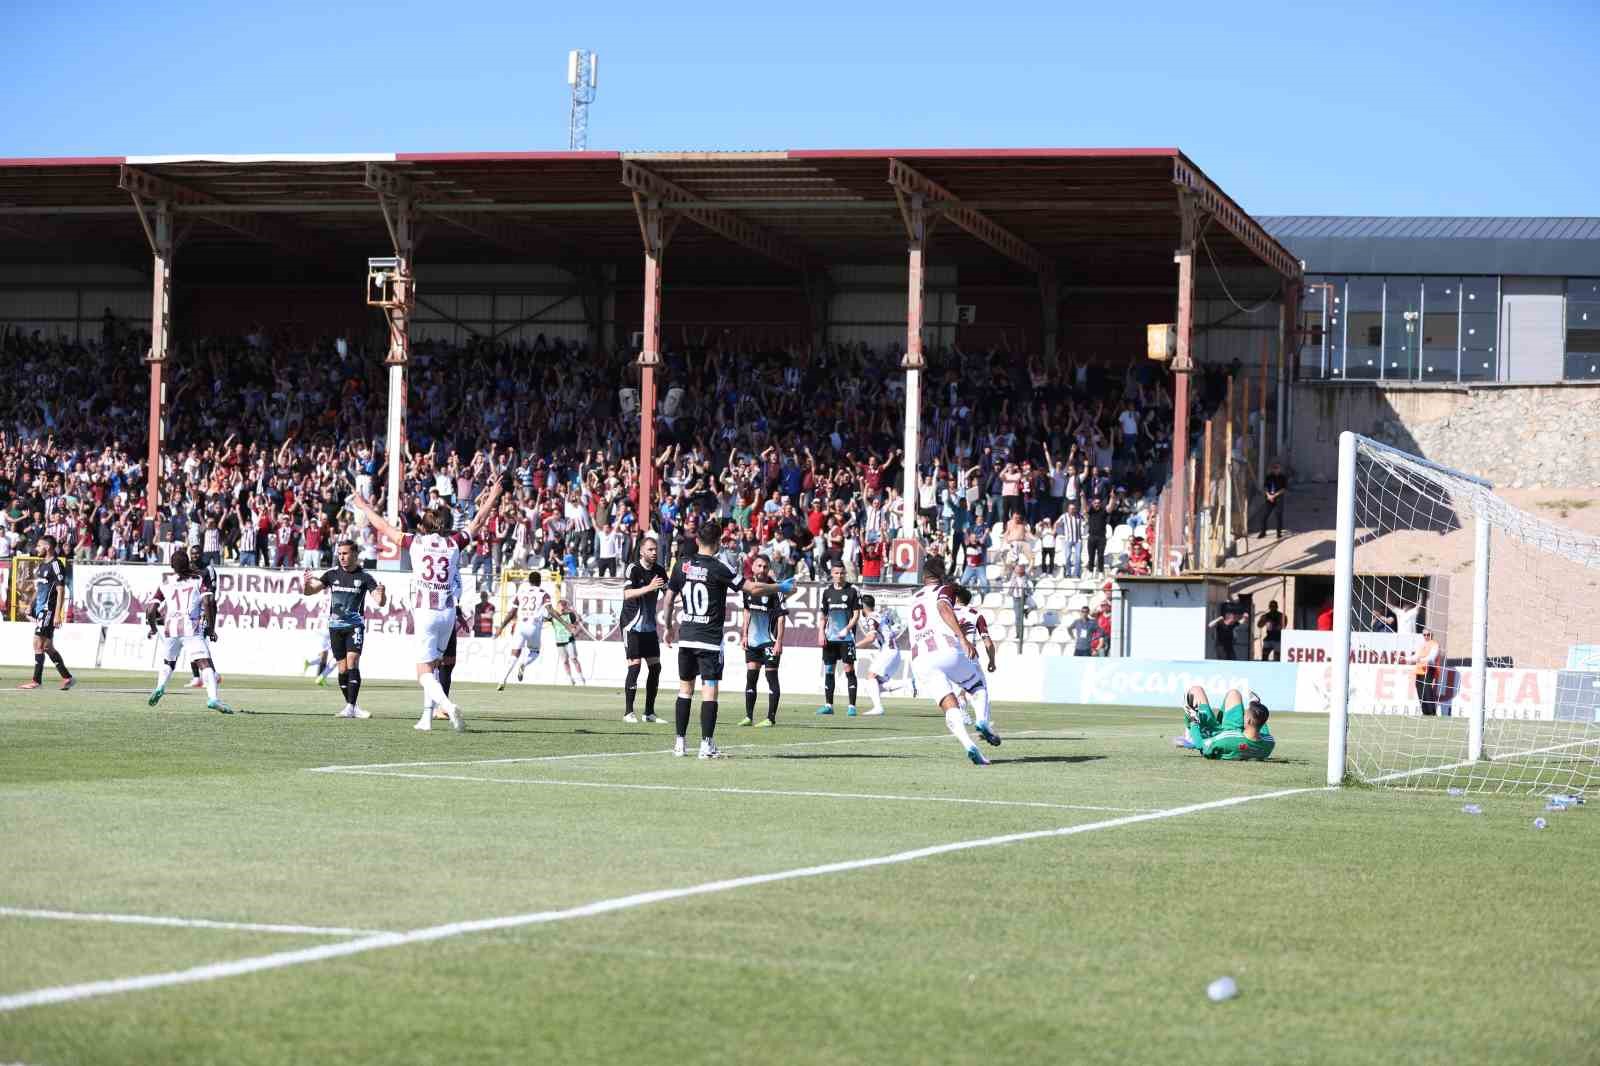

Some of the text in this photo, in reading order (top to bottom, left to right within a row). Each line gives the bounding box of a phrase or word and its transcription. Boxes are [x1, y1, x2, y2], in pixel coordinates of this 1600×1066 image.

[421, 555, 449, 583] 33
[171, 586, 194, 611] 17
[520, 595, 537, 611] 23
[682, 581, 709, 616] 10
[911, 603, 928, 631] 9
